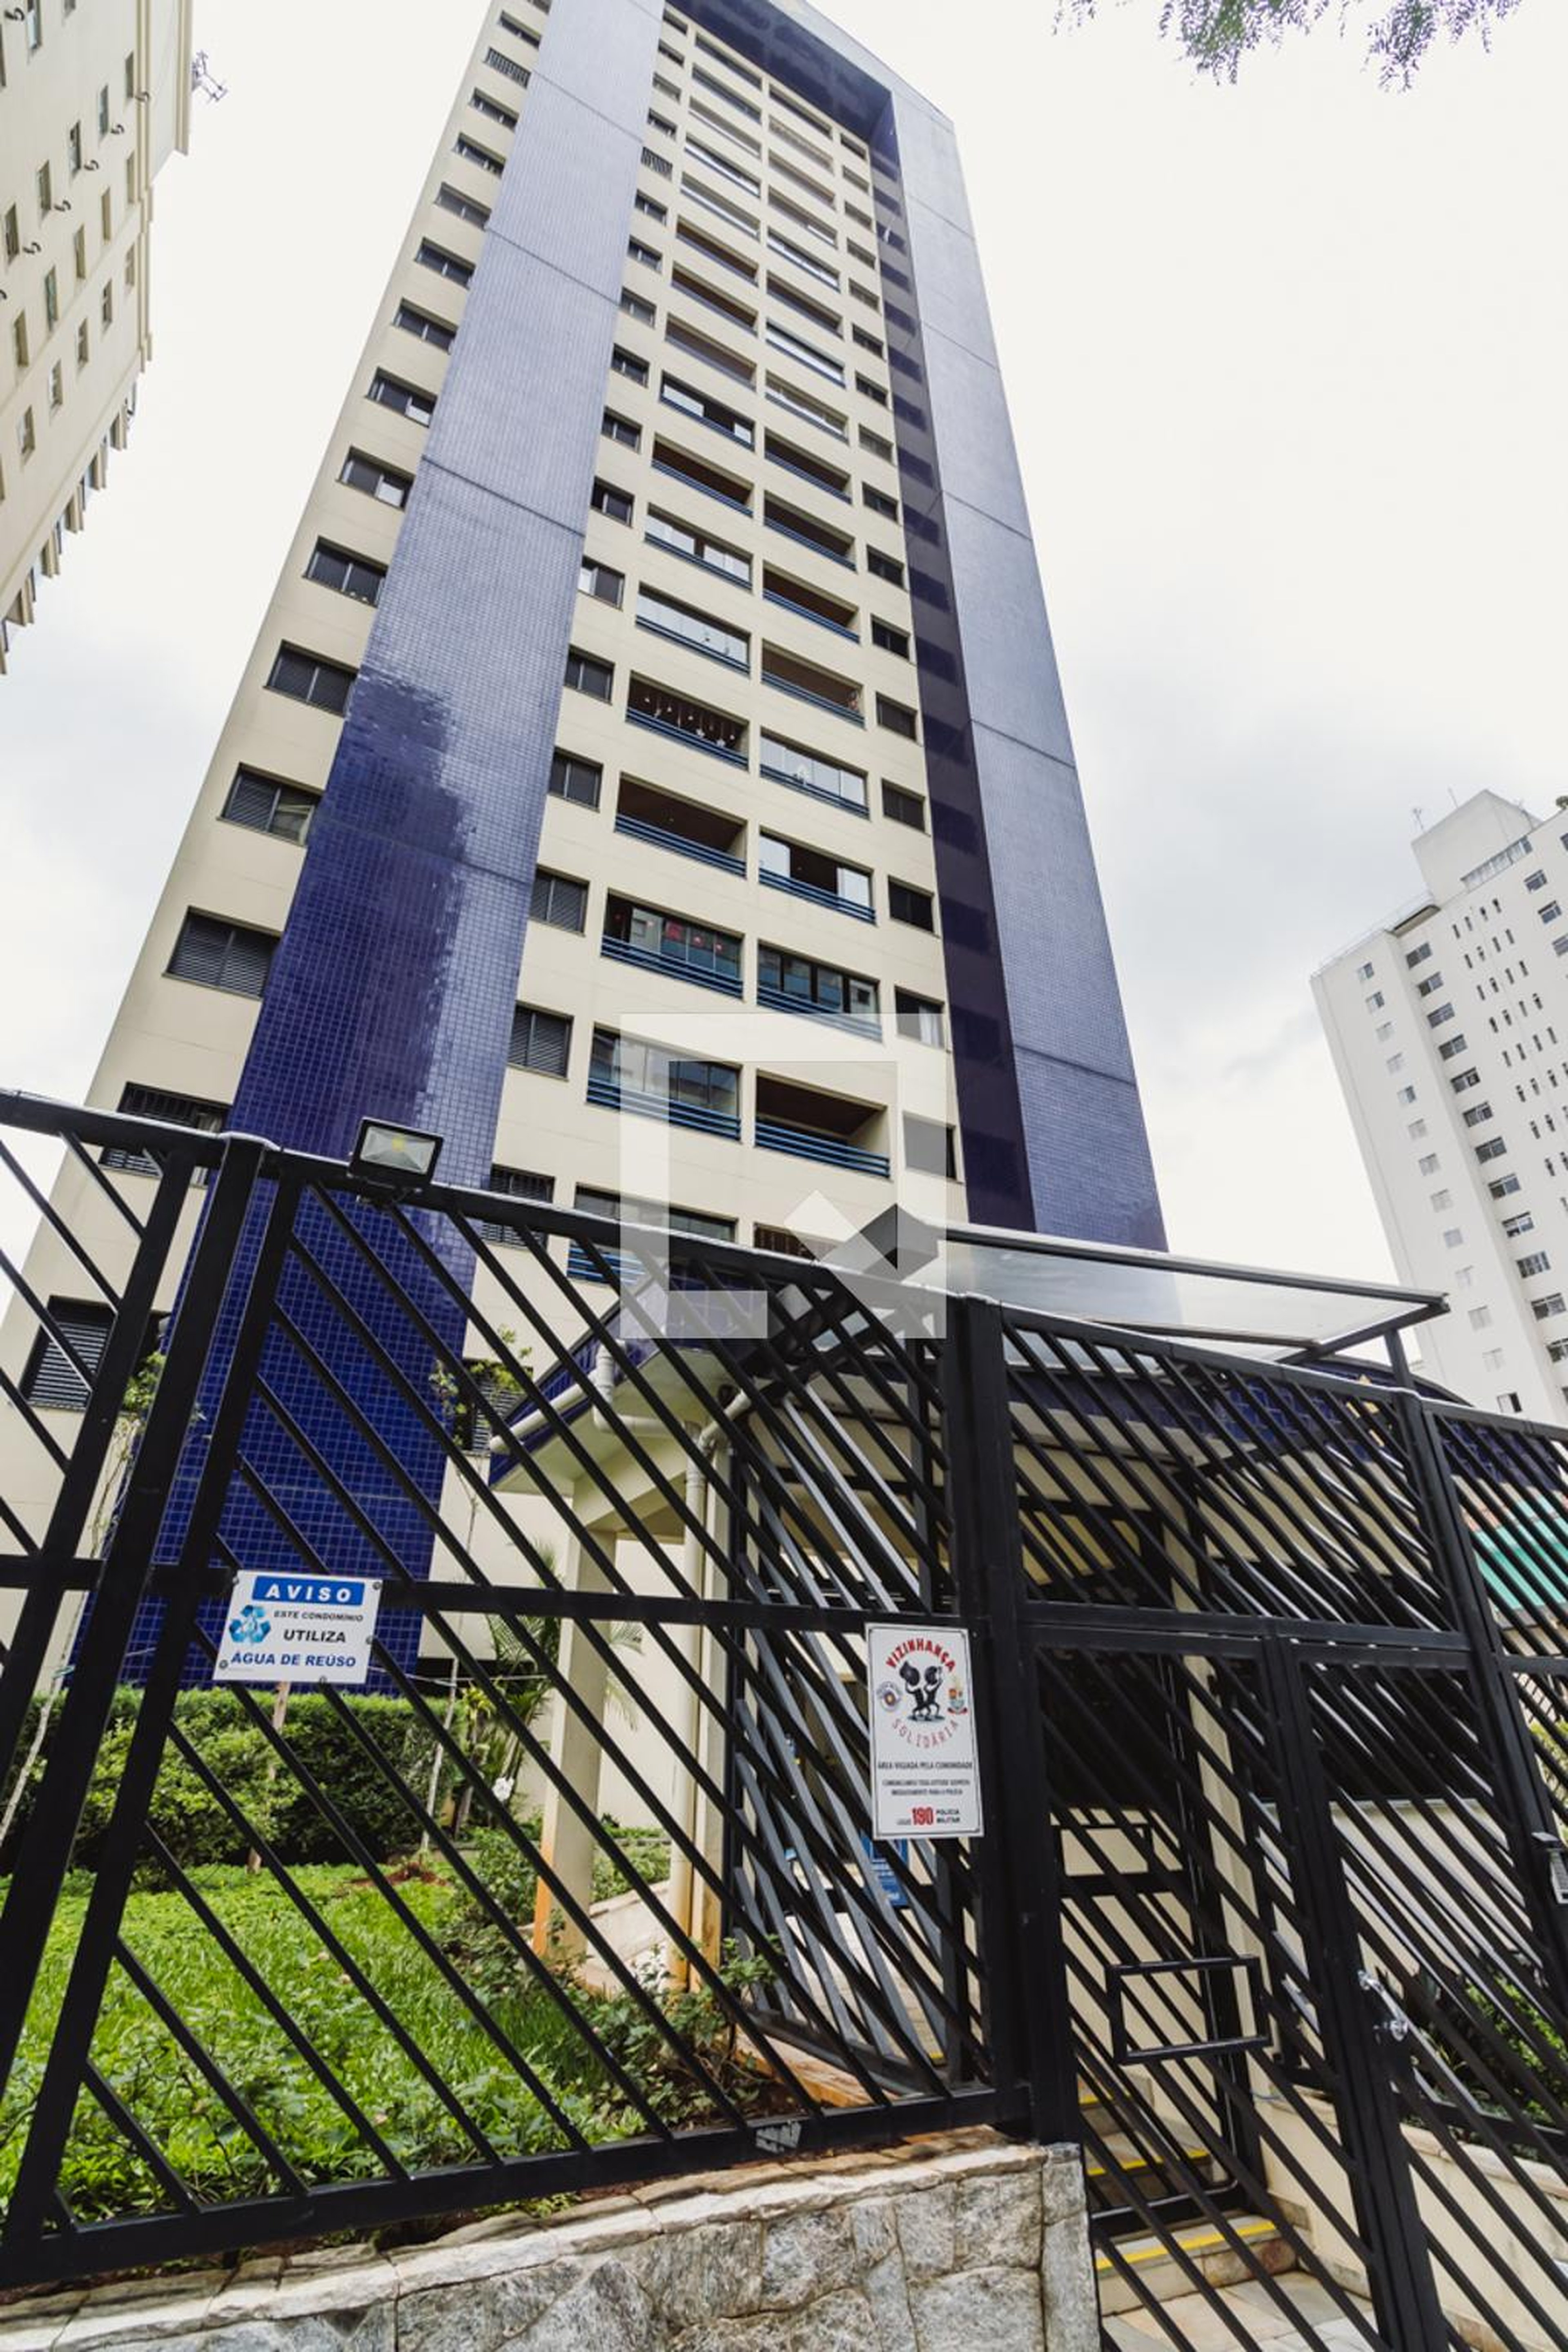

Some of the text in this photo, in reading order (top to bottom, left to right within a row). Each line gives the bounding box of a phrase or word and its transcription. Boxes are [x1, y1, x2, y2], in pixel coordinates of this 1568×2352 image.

[265, 1583, 351, 1603] AVISO
[274, 1610, 298, 1619] ESTE
[283, 1629, 346, 1643] UTILIZA
[231, 1650, 275, 1664] ÁGUA
[280, 1654, 301, 1666] DE
[912, 1806, 933, 1825] 190
